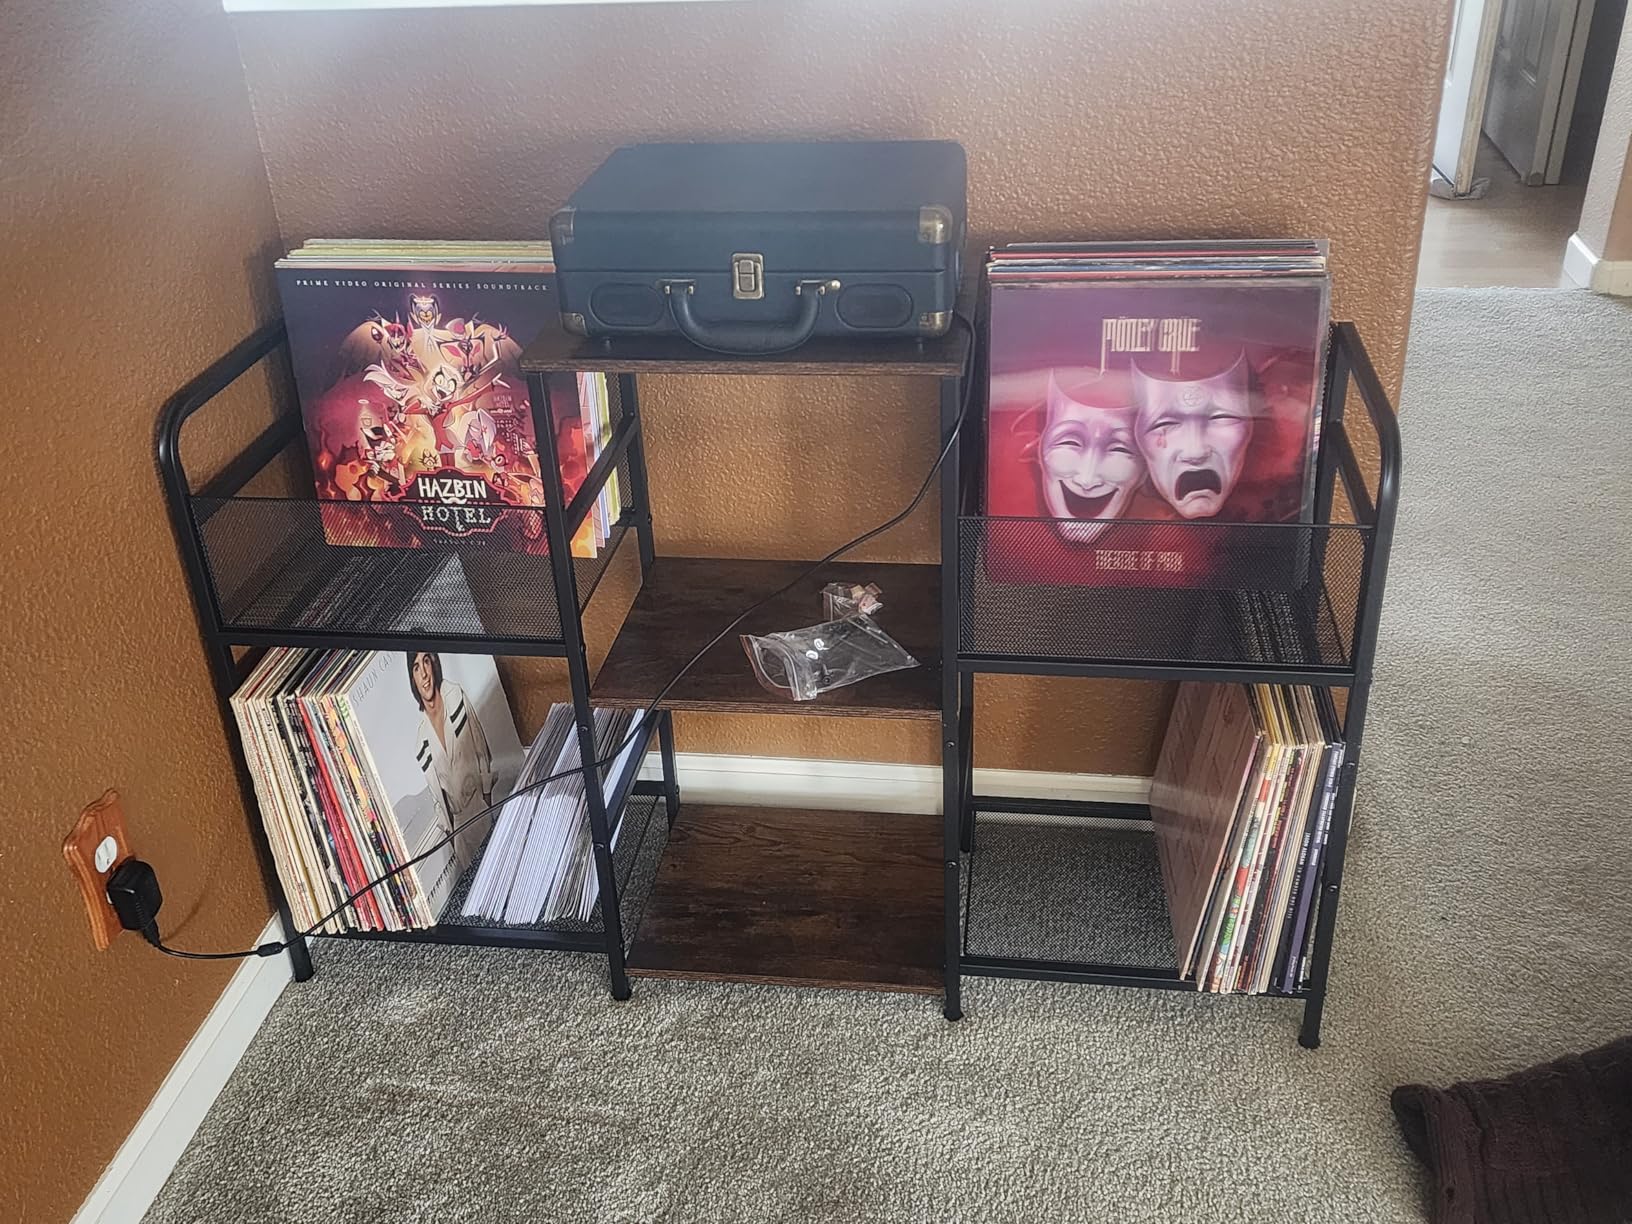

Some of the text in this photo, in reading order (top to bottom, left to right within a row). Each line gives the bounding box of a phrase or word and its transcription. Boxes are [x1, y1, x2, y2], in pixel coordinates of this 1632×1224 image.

[476, 283, 548, 291] SOUNDTRACK
[417, 477, 487, 499] HAZBIN
[421, 505, 492, 531] HOTEL
[352, 667, 379, 707] SHAUN
